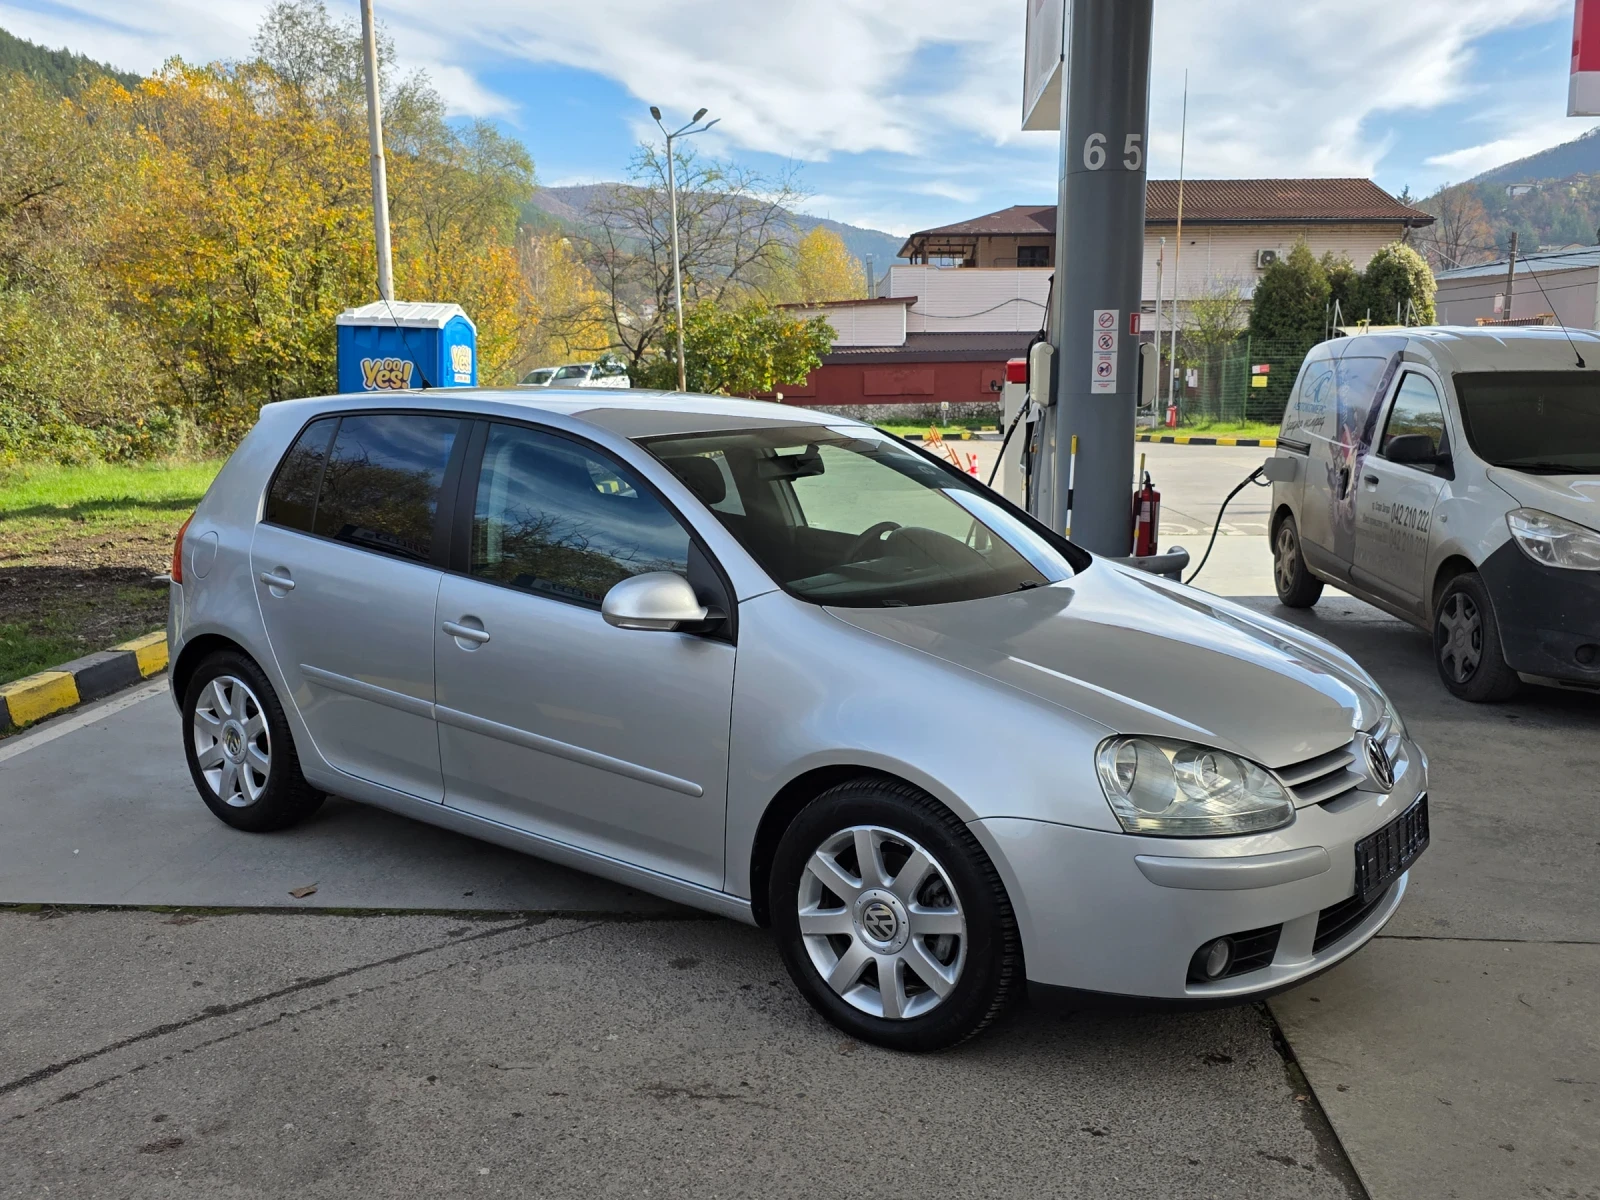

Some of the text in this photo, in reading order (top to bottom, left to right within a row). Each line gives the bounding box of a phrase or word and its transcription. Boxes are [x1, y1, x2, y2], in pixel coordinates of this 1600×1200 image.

[1083, 132, 1142, 171] 6 5
[362, 359, 412, 389] Yes!
[1391, 502, 1404, 525] 042
[1403, 505, 1417, 529] 210
[1416, 509, 1430, 533] 222
